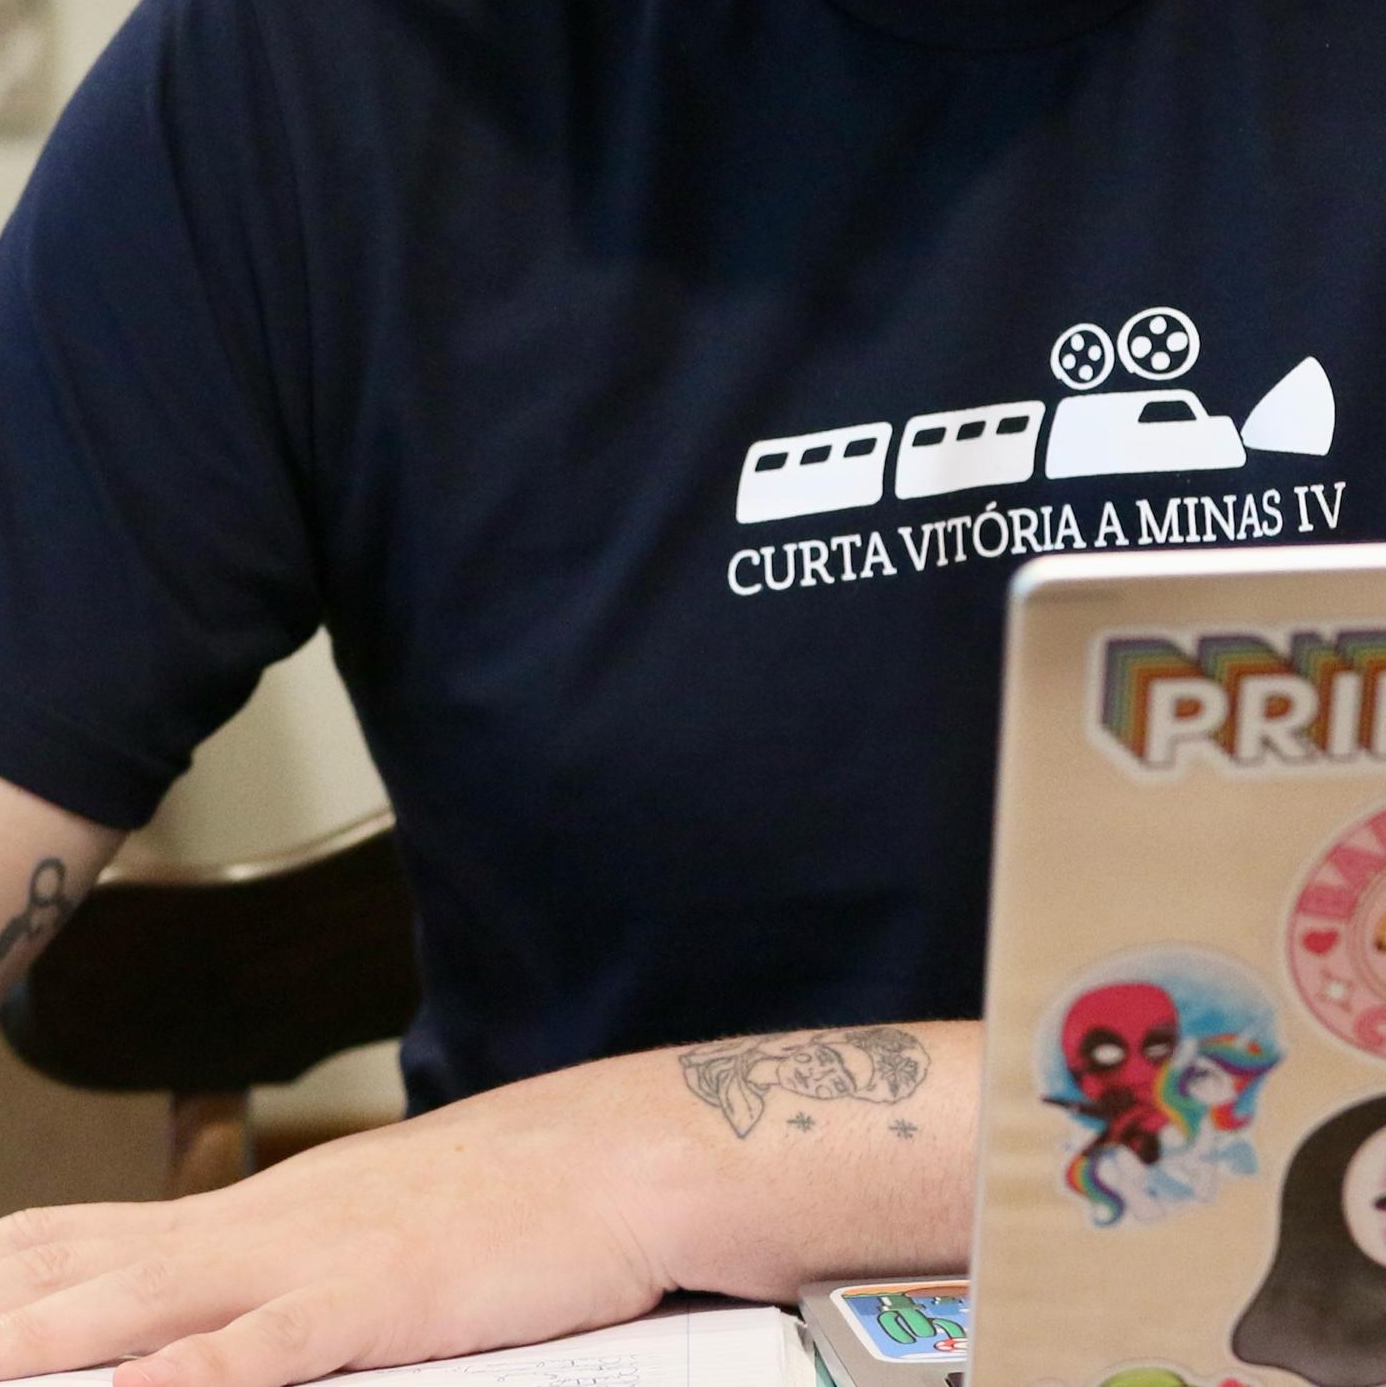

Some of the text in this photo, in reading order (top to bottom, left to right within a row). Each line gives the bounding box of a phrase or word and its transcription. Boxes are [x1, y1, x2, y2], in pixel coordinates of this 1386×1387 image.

[727, 481, 1346, 596] CURTA VITÓRIA A MINAS IV
